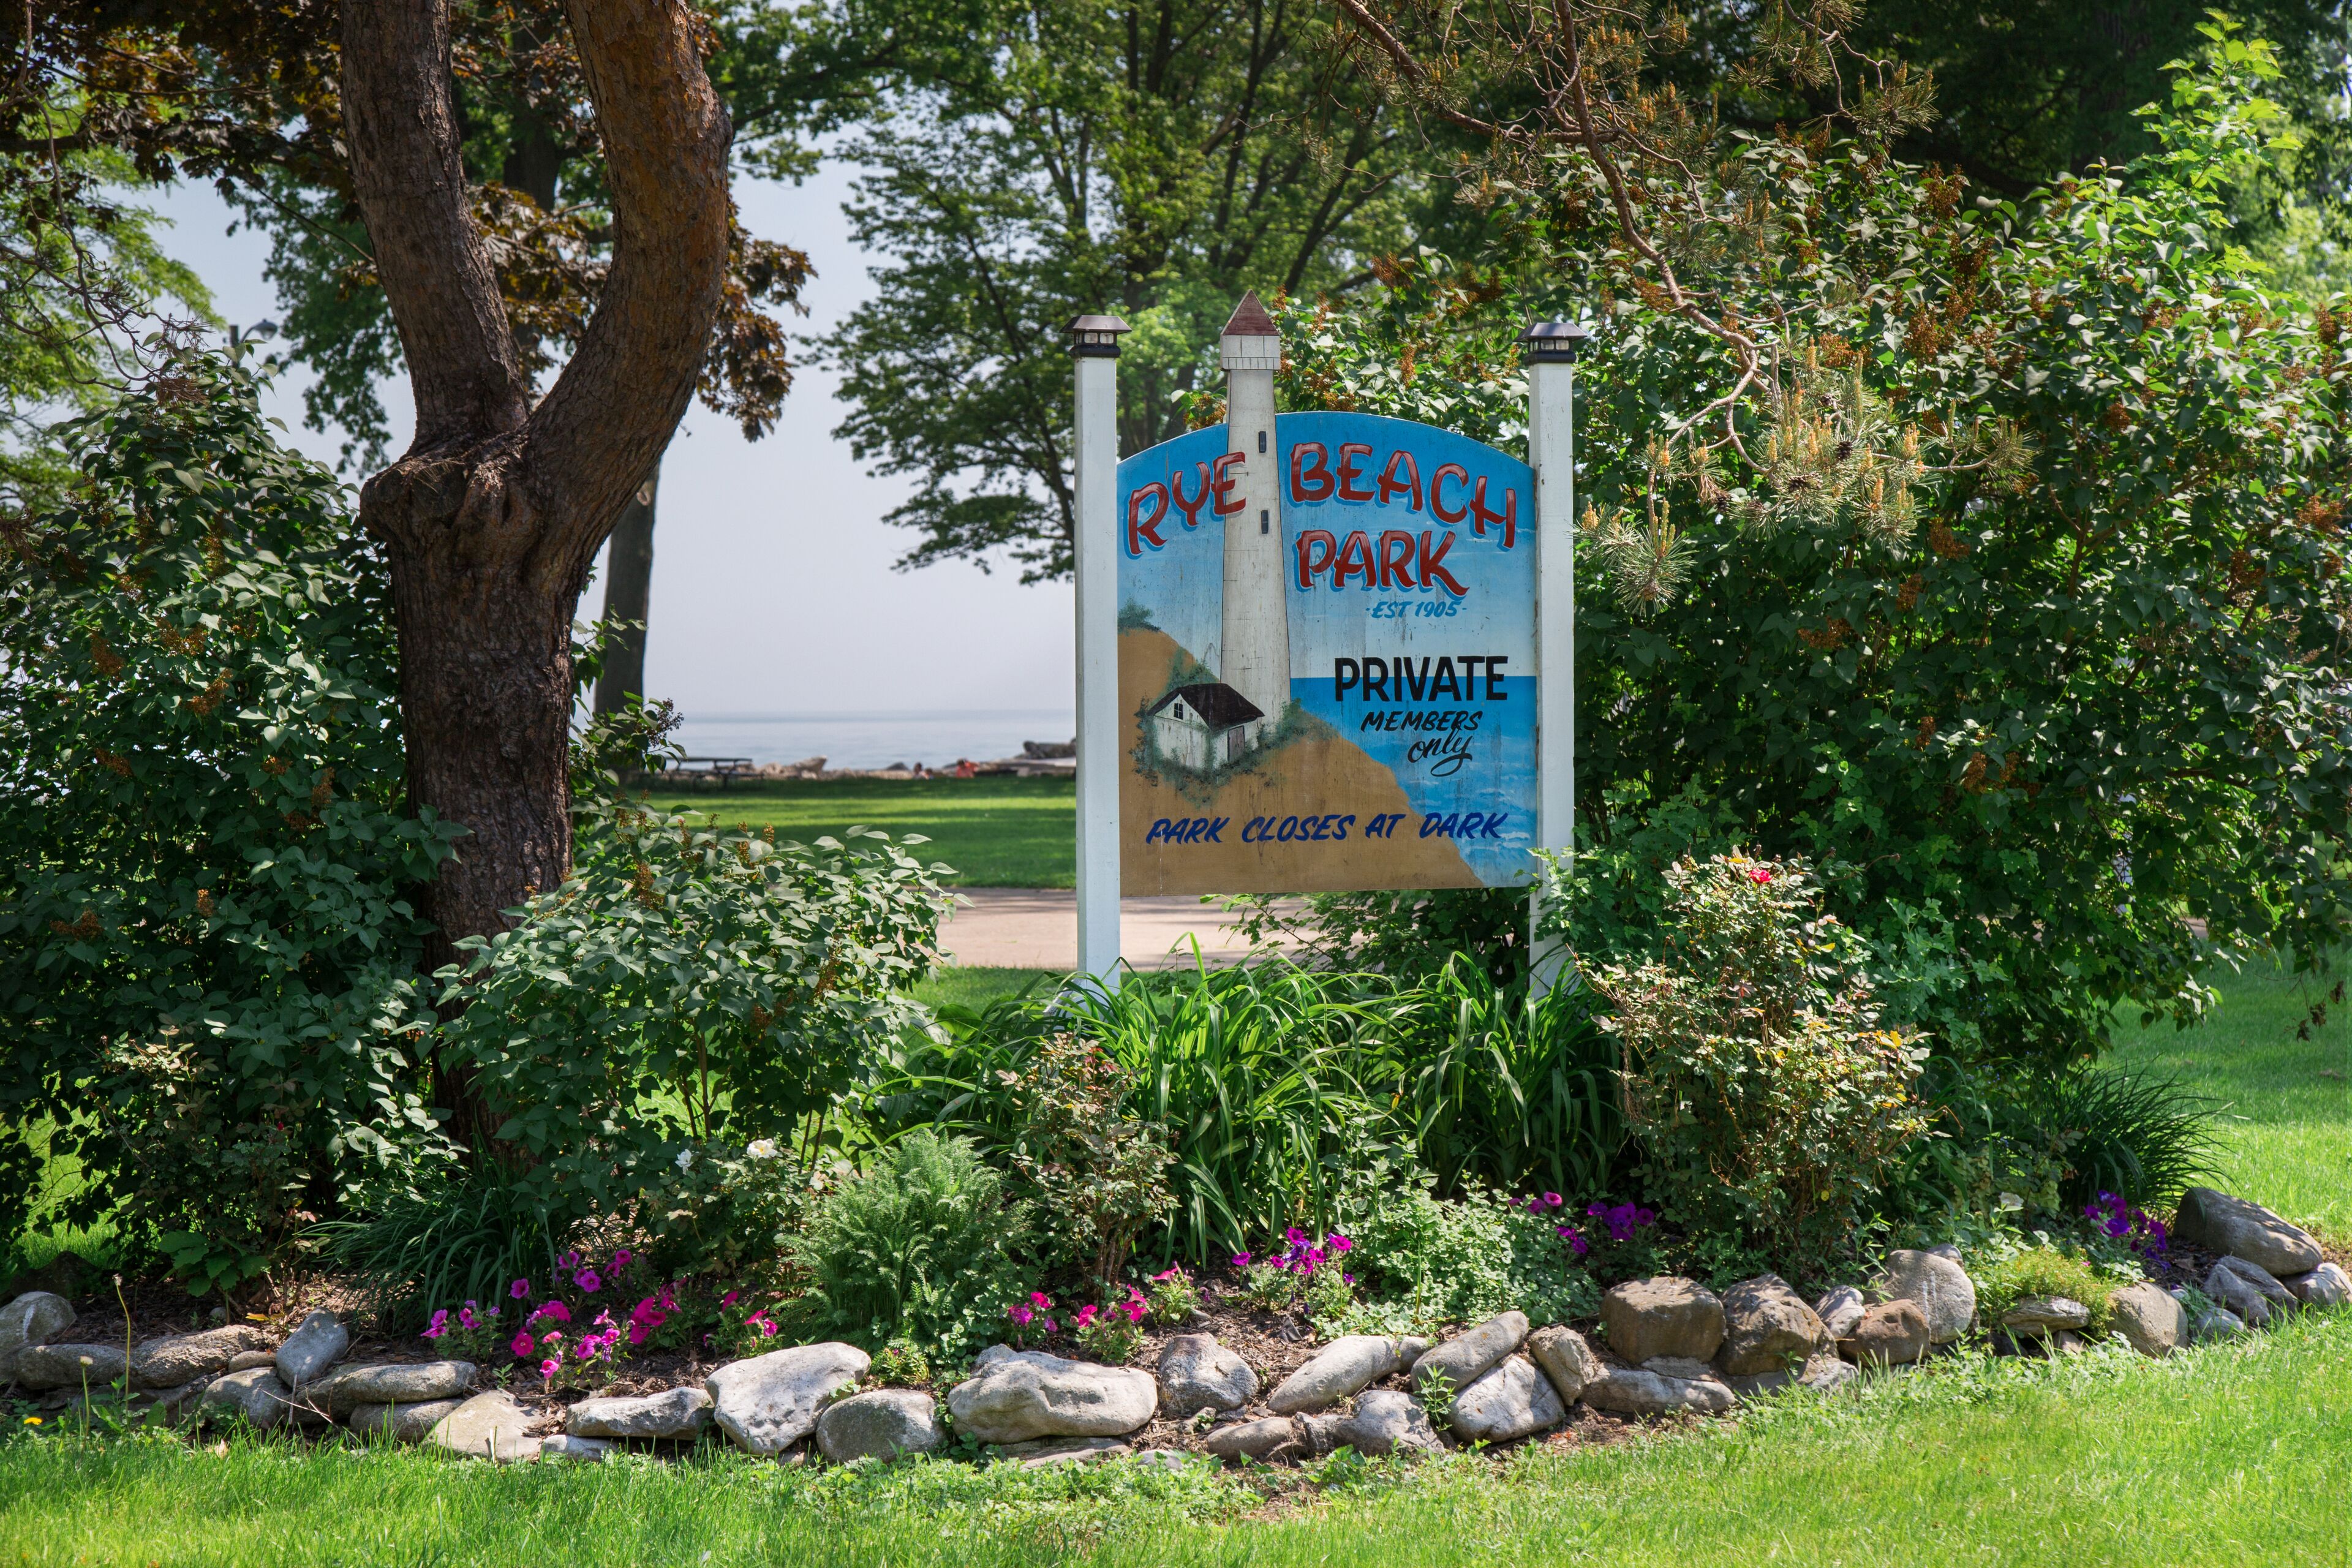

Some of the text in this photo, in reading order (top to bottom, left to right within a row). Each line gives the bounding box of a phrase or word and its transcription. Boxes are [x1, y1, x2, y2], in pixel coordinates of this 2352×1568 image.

[1128, 442, 1516, 556] RYE BEACH
[1296, 530, 1470, 597] PARK
[1334, 655, 1509, 702] PRIVATE
[1360, 710, 1483, 732] MEMBERS
[1408, 723, 1474, 777] only
[1145, 812, 1509, 845] PARK CLOSES AT DARK
